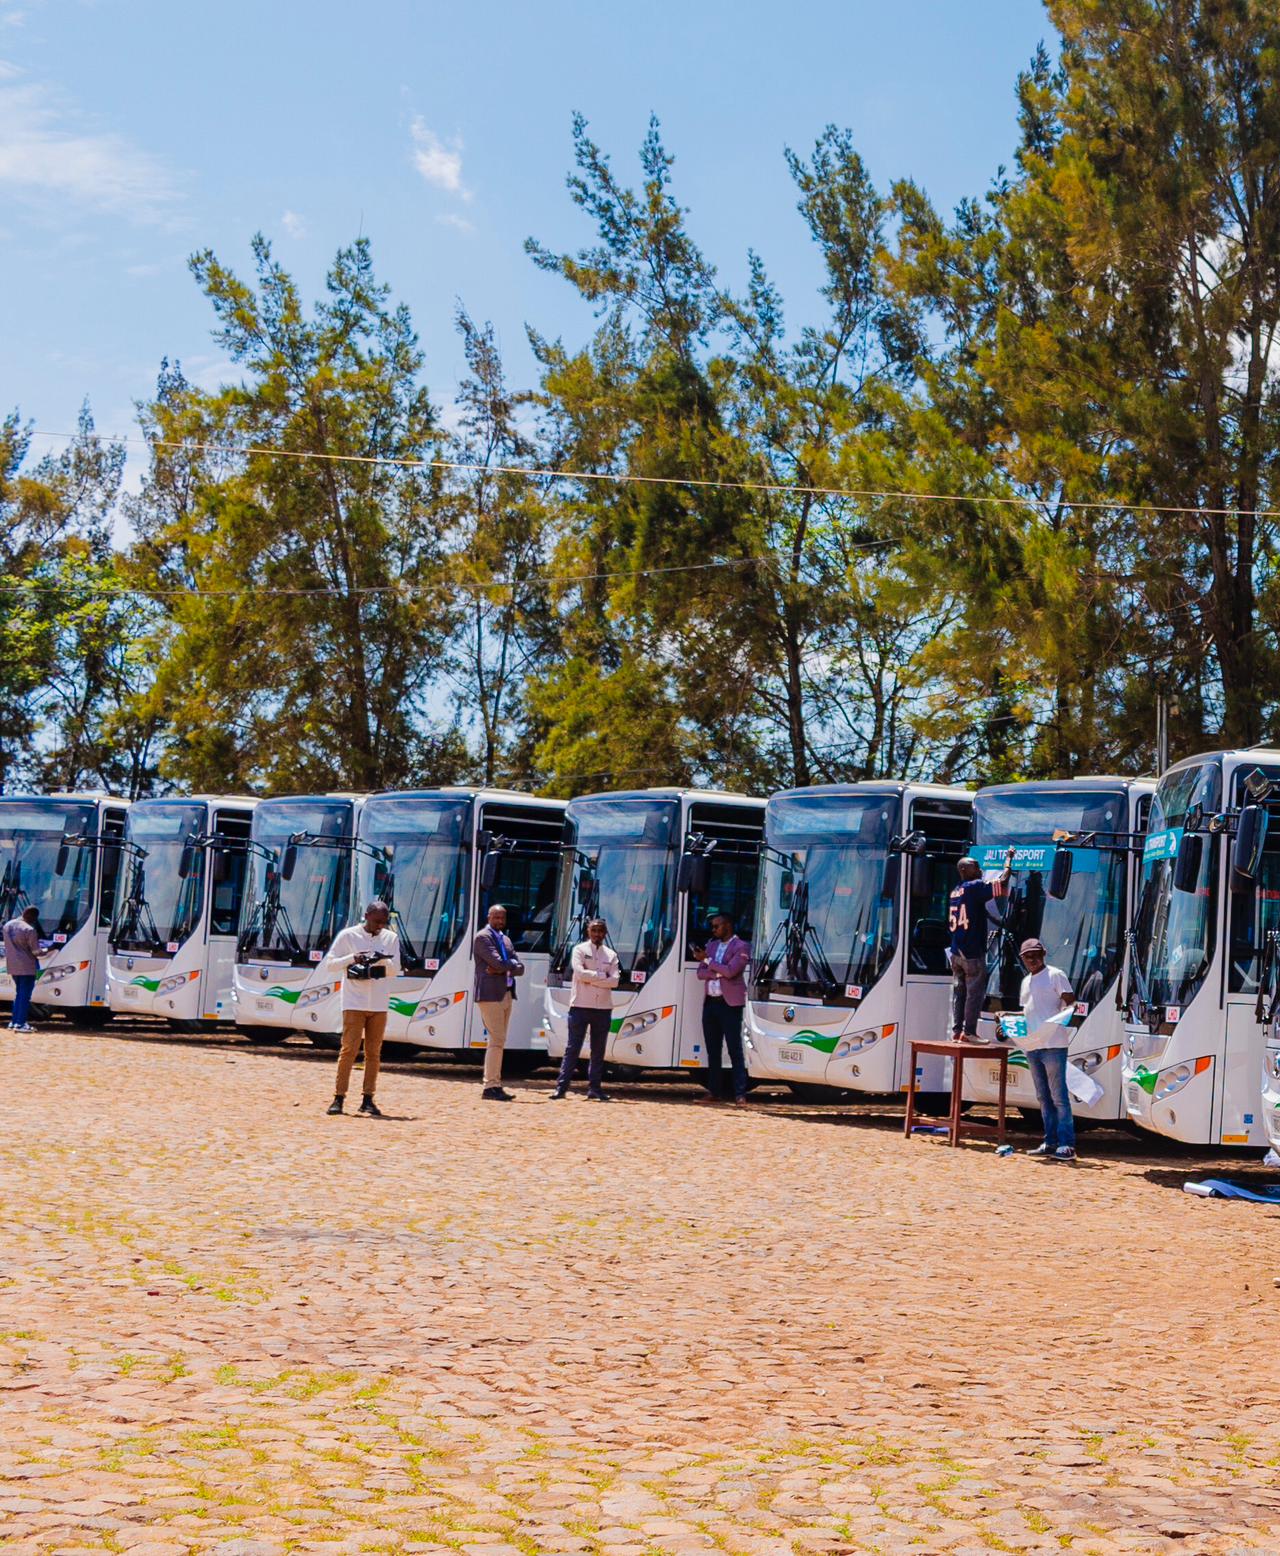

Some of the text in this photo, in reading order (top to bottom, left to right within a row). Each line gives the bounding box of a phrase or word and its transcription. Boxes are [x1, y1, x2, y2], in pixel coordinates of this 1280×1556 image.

[984, 849, 1046, 861] JALI TRNSPORT
[949, 904, 969, 932] 54
